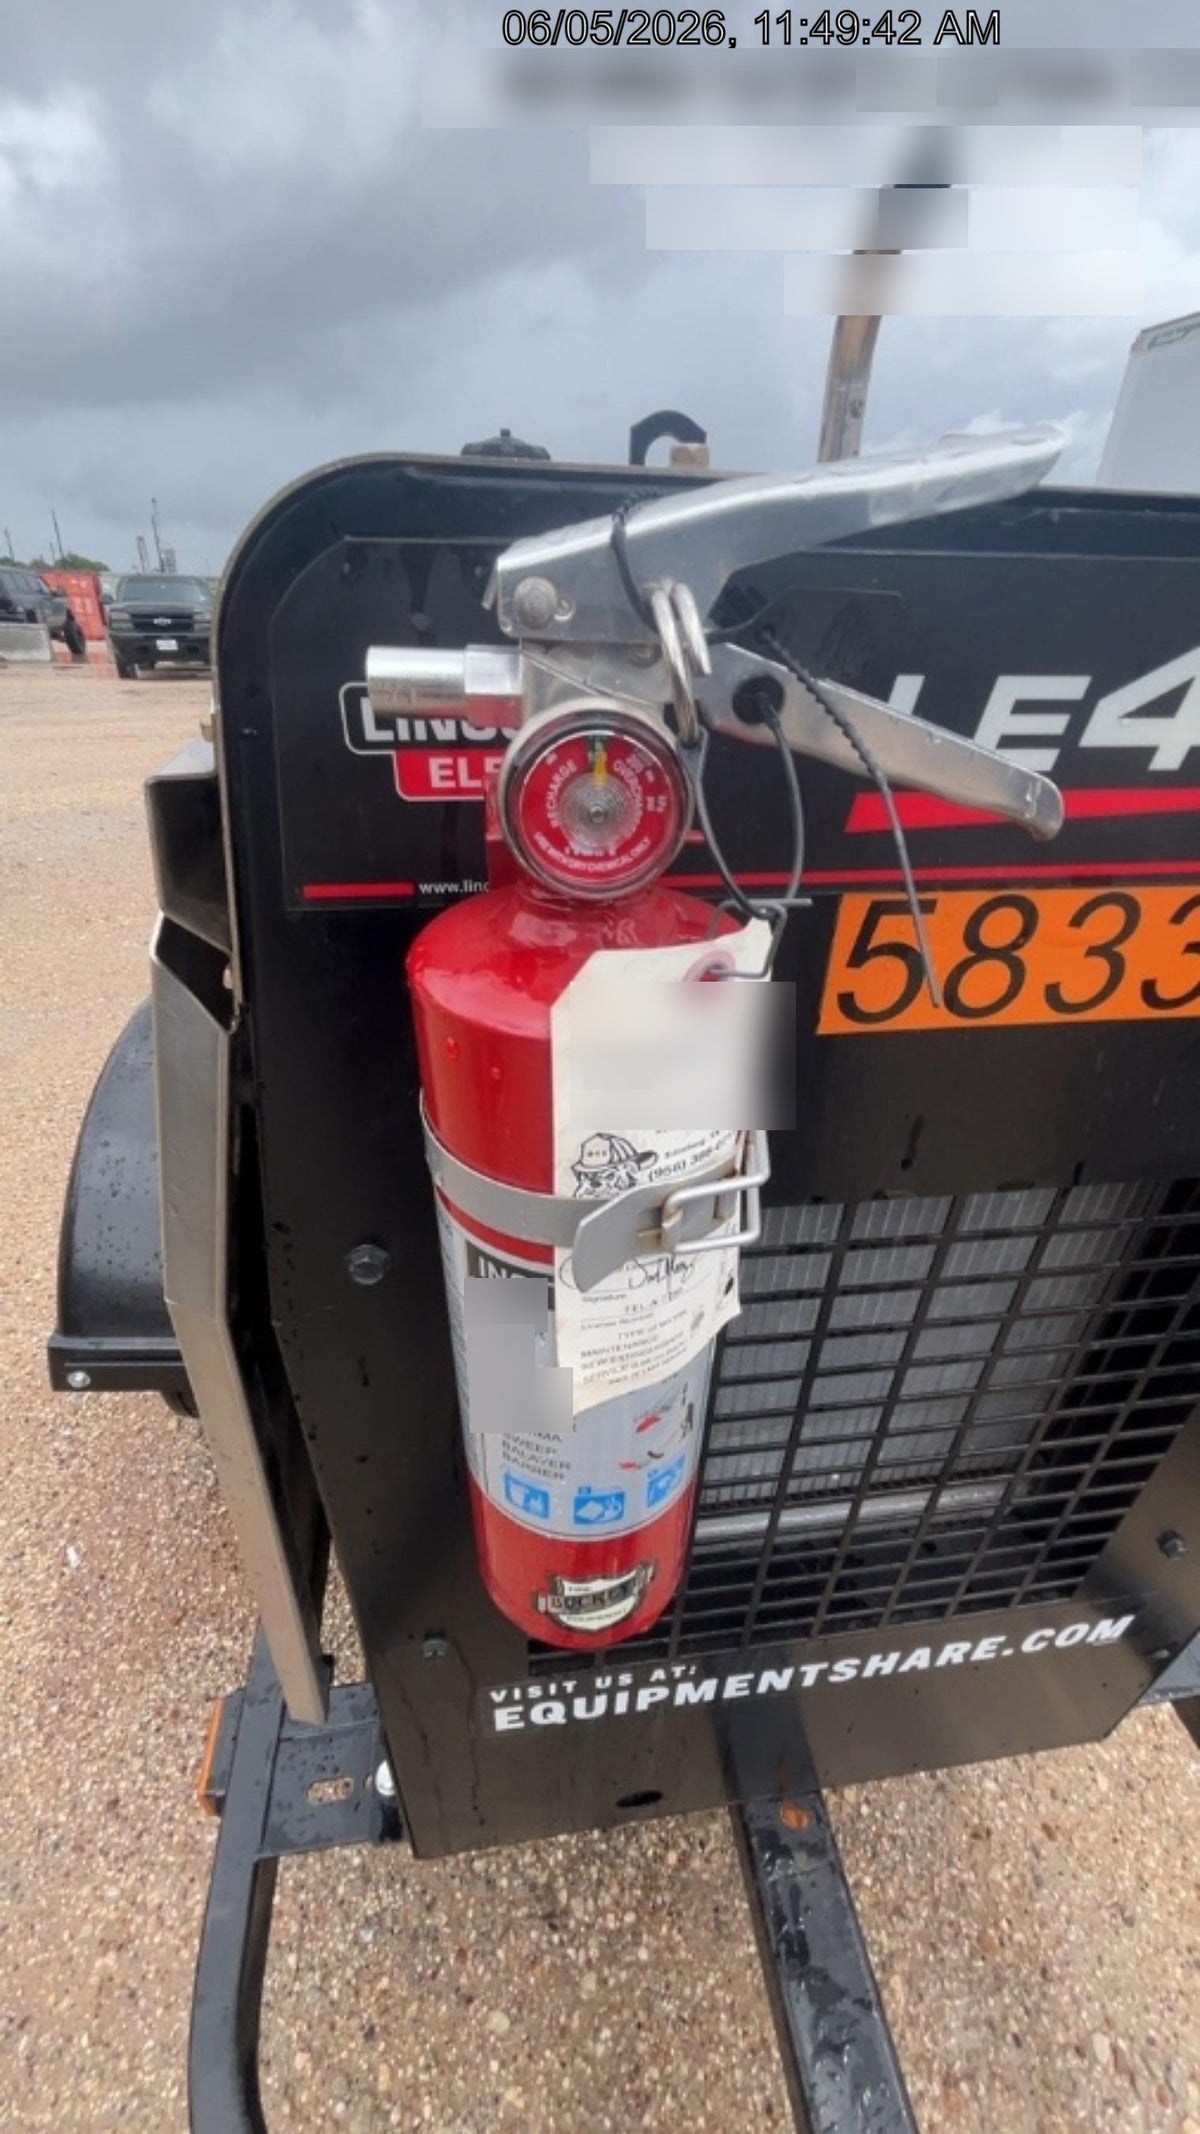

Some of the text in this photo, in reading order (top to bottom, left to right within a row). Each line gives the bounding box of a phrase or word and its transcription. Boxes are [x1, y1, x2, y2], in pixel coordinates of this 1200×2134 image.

[490, 1665, 697, 1703] VISIT US AT:
[493, 1613, 1136, 1732] EQUIPMENTSHARE.COM
